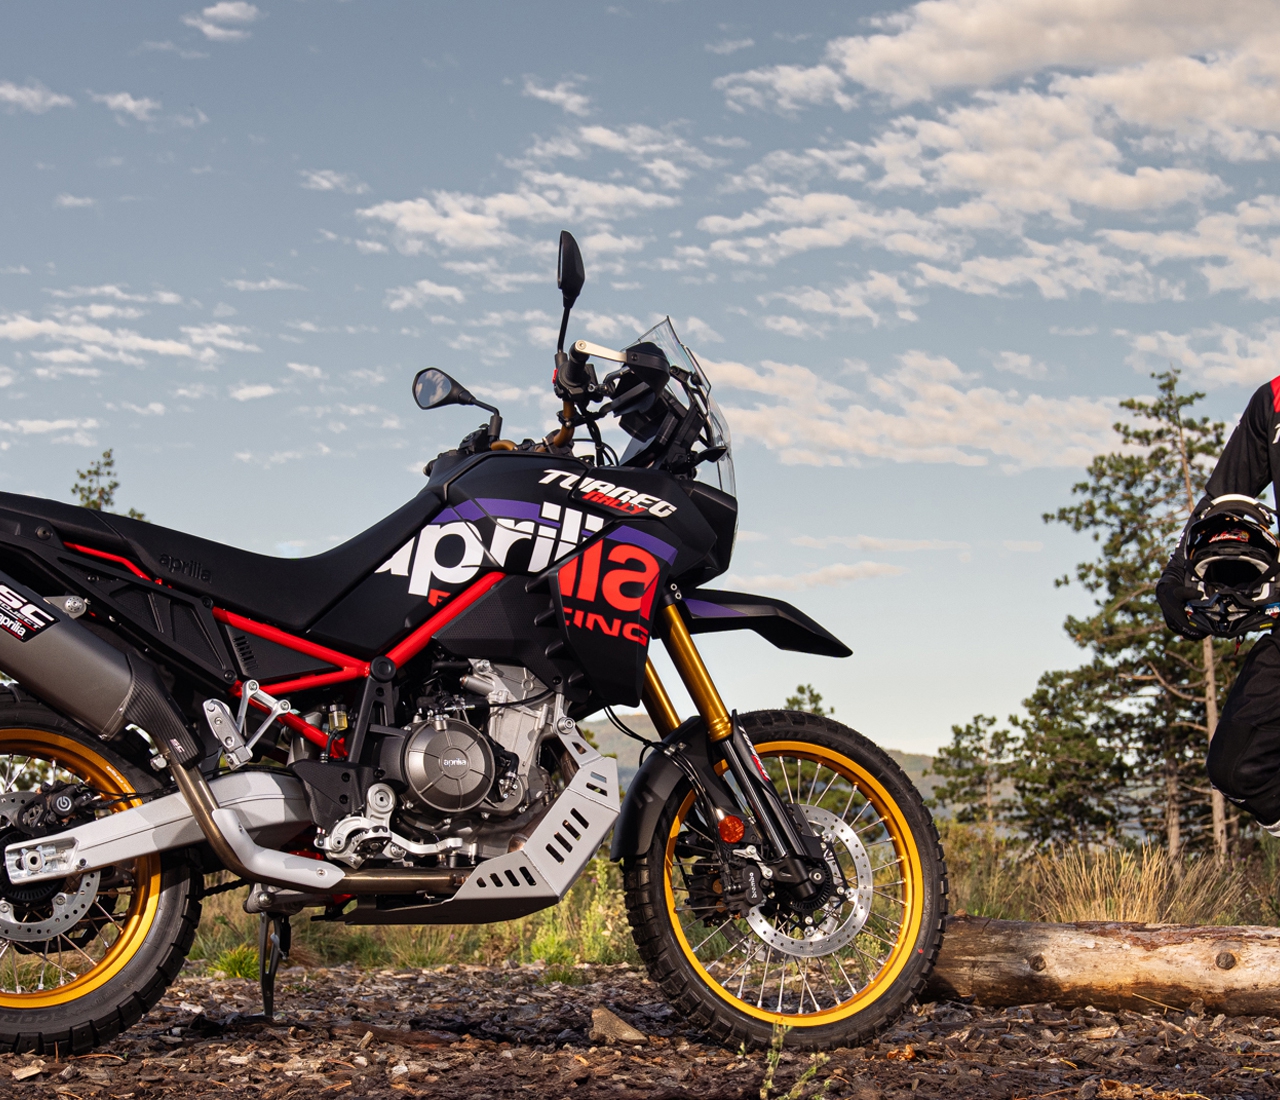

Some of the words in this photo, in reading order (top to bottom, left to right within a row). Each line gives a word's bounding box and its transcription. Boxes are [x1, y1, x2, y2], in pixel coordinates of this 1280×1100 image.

[539, 469, 677, 518] TUAREG
[582, 490, 646, 515] RALLY
[159, 553, 213, 584] aprilia
[443, 757, 467, 768] aprilia
